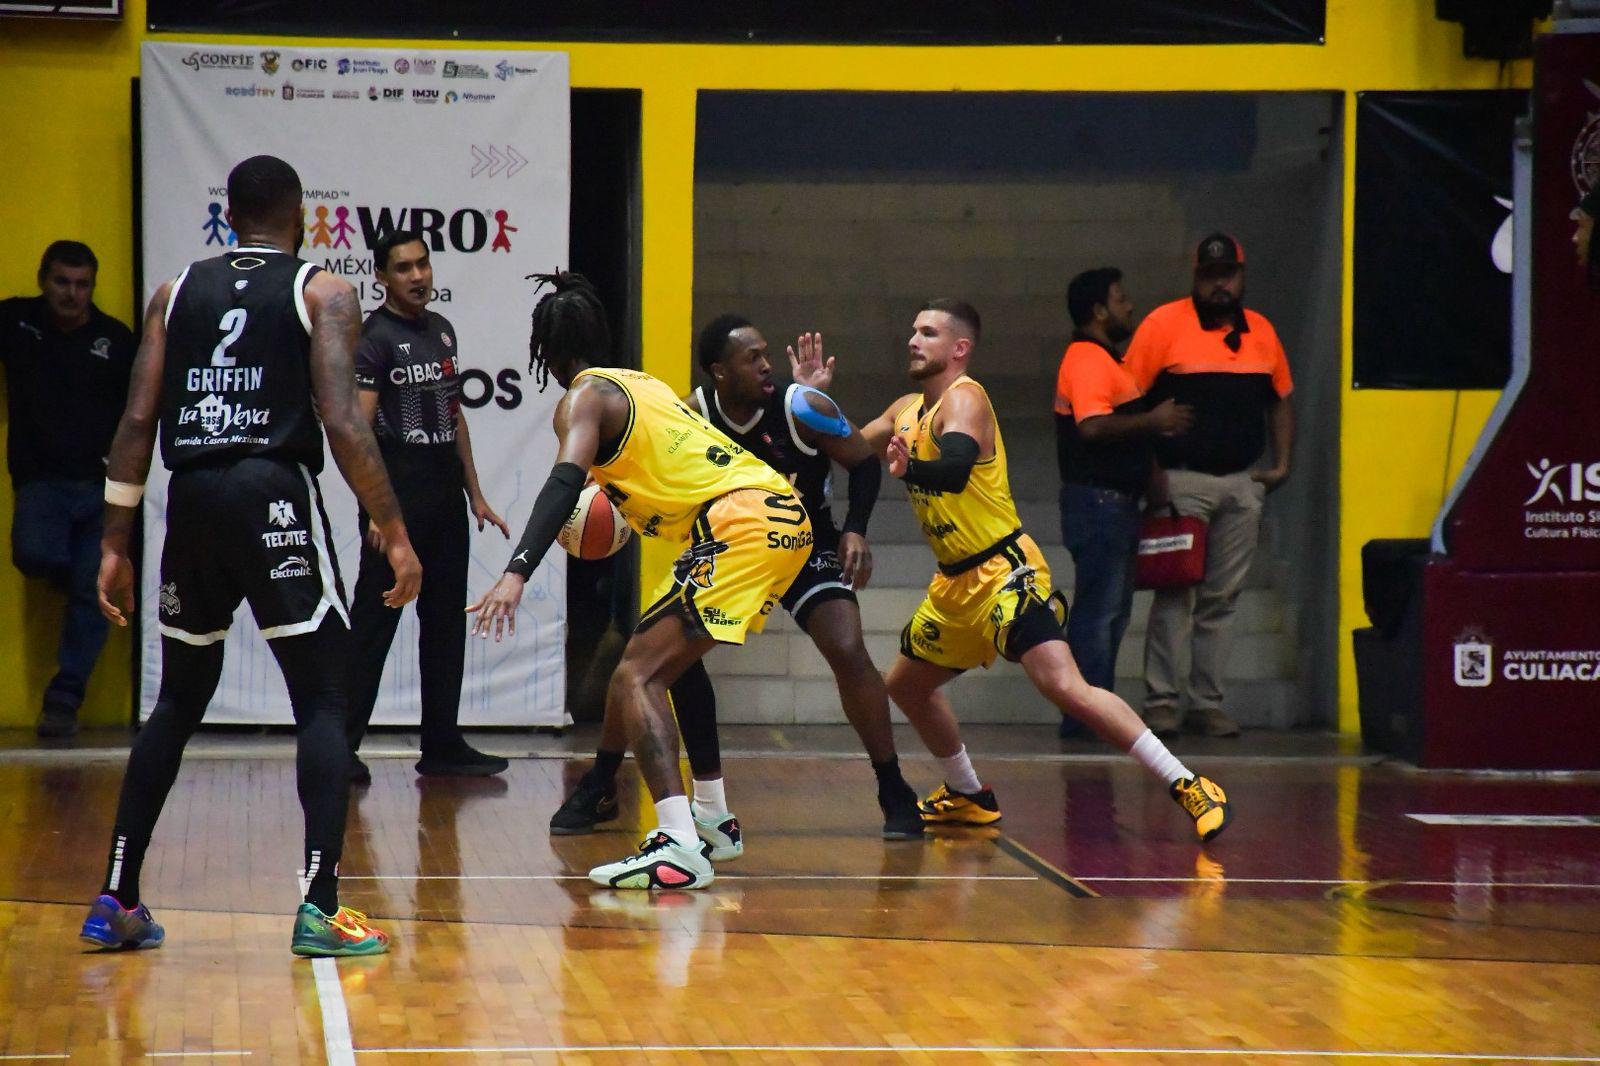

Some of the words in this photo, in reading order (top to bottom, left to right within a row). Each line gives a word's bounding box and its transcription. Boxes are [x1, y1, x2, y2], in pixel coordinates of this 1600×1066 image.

[384, 89, 404, 98] DIF
[412, 89, 439, 98] IMJU
[211, 308, 248, 367] 2
[187, 366, 264, 392] GRIFFIN
[1570, 463, 1600, 502] IS
[1525, 511, 1585, 522] Instituto
[262, 530, 308, 548] TECATE
[767, 531, 813, 552] SoniGa
[1525, 527, 1569, 538] Cultura
